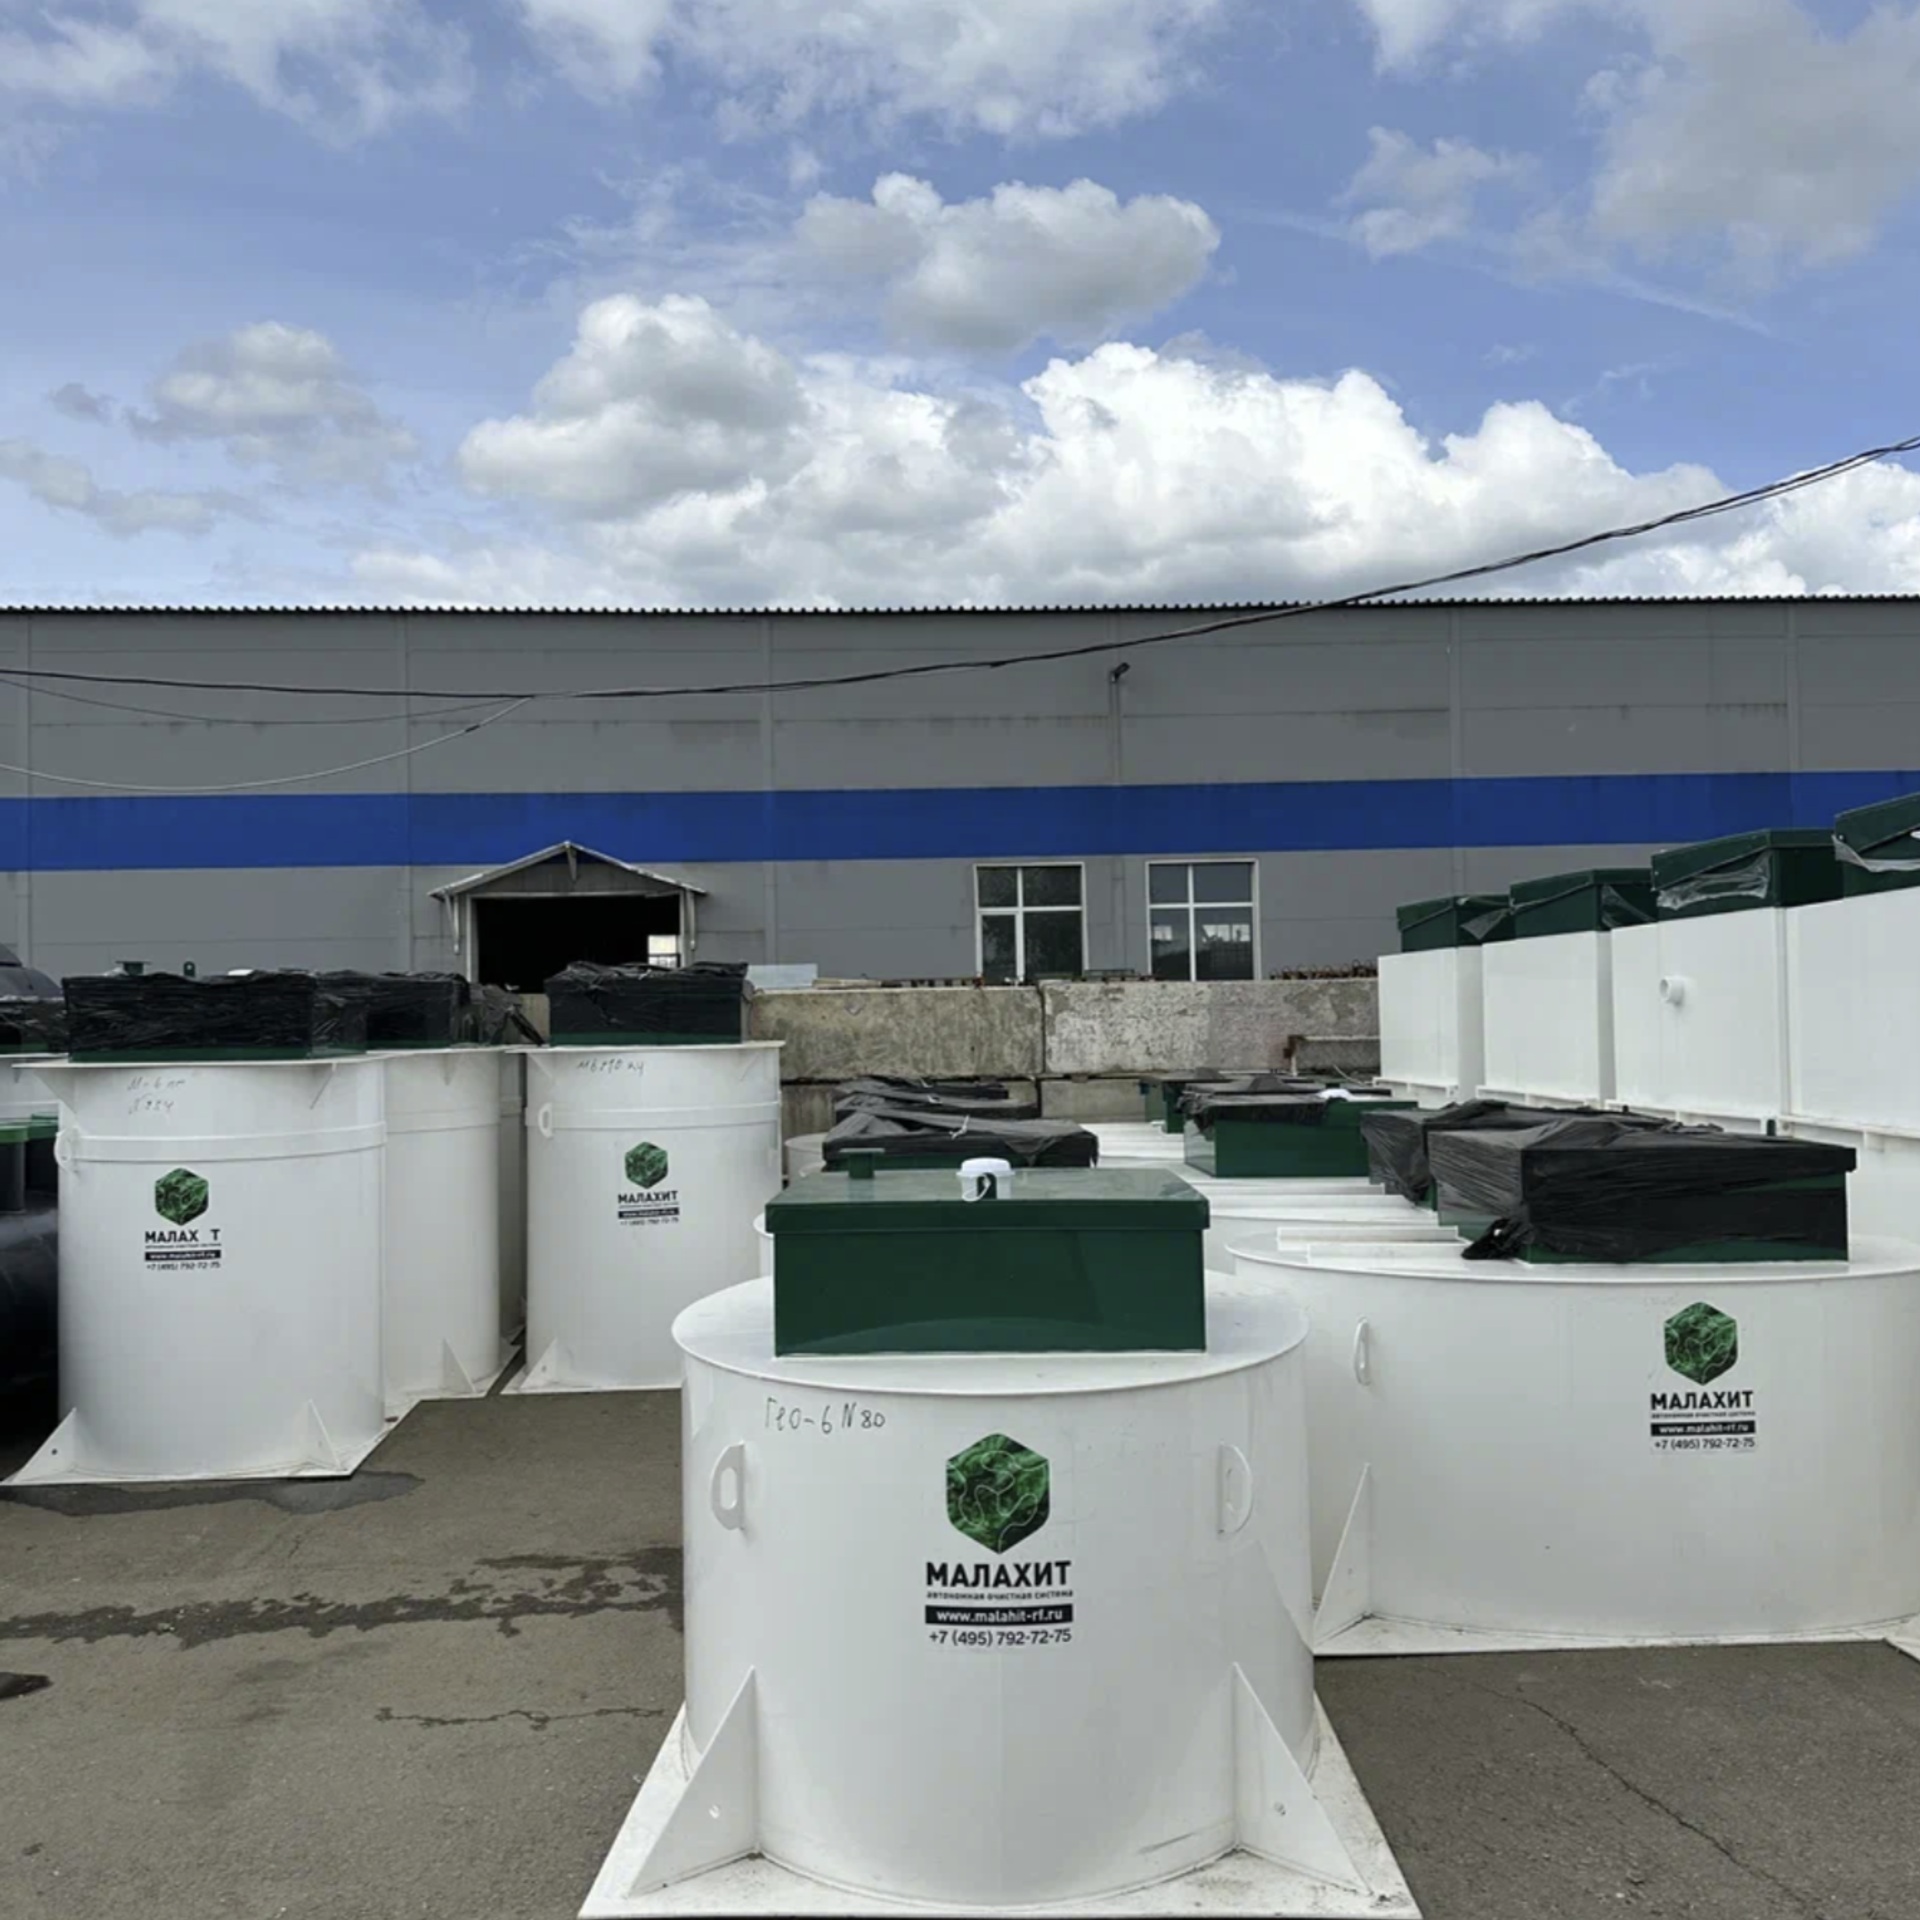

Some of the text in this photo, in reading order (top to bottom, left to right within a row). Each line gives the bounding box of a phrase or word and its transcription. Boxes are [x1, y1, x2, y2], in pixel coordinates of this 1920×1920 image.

[618, 1190, 678, 1204] МАЛАХИТ
[145, 1229, 221, 1244] МАЛАХТ
[1650, 1390, 1754, 1411] МАЛАХИТ
[1659, 1423, 1749, 1434] www.malahit-rf.ru
[1654, 1437, 1755, 1451] +7 (495) 792-72-75
[926, 1560, 1072, 1588] МАЛАХИТ
[926, 1589, 1074, 1601] автономная очистная система
[936, 1609, 1063, 1623] www.malahit-rf.ru
[929, 1628, 1072, 1647] +7 (495) 792-72-75
